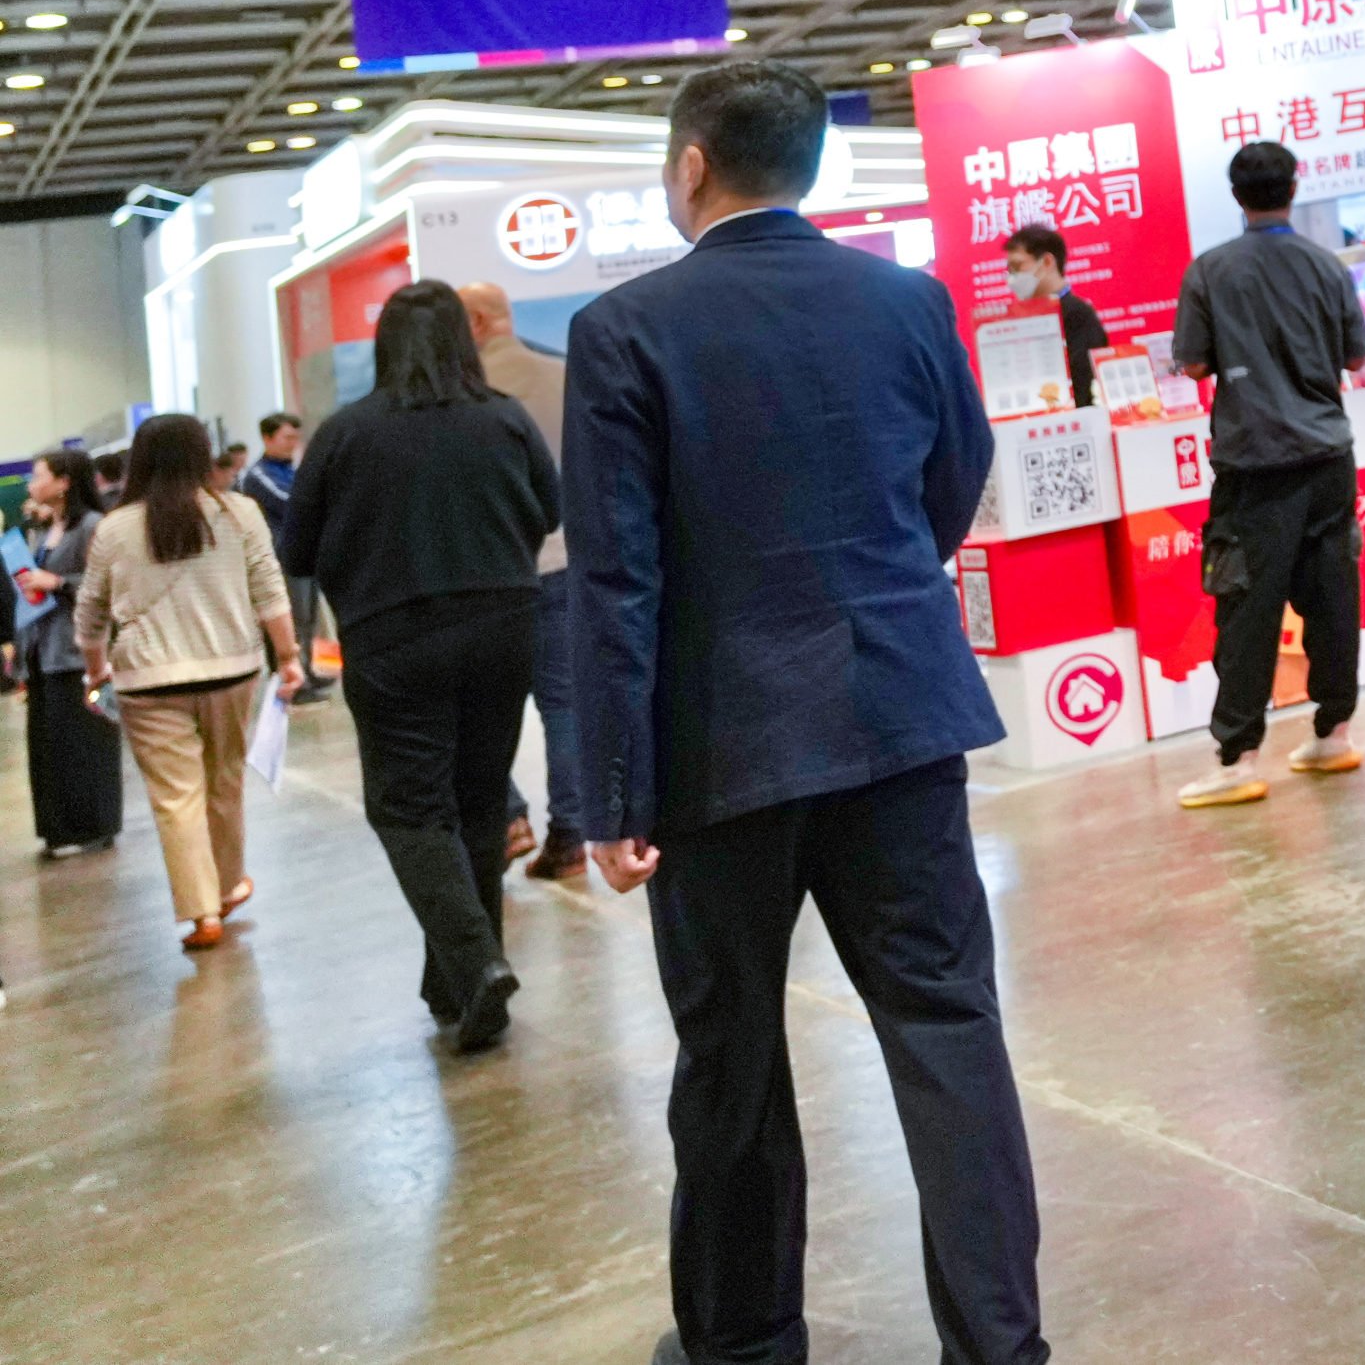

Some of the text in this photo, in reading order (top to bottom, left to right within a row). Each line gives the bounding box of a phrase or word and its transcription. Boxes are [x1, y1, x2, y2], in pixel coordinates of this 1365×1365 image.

[968, 173, 1144, 244] 旗艦公司
[1147, 528, 1203, 561] 陪你
